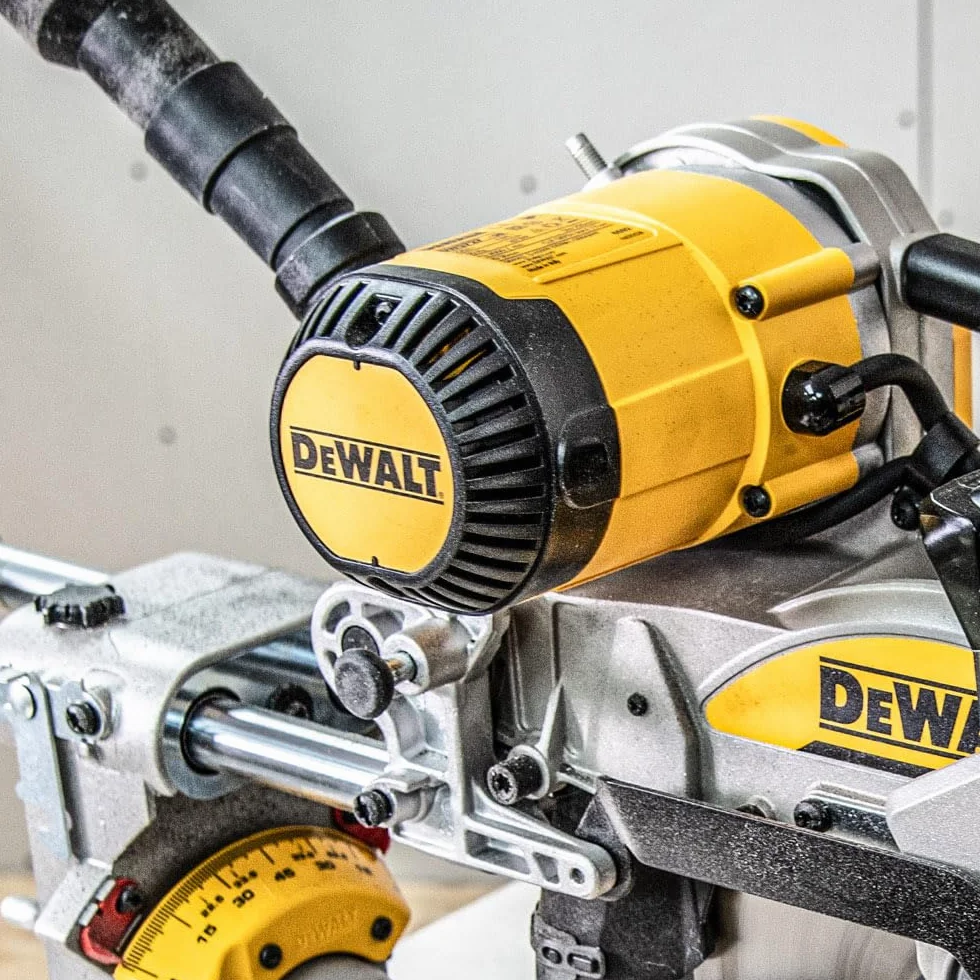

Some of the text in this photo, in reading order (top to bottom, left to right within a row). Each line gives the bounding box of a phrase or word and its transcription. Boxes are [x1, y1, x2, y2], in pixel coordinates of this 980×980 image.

[290, 431, 441, 498] DEWALT
[197, 924, 217, 943] 15
[232, 889, 255, 908] 30
